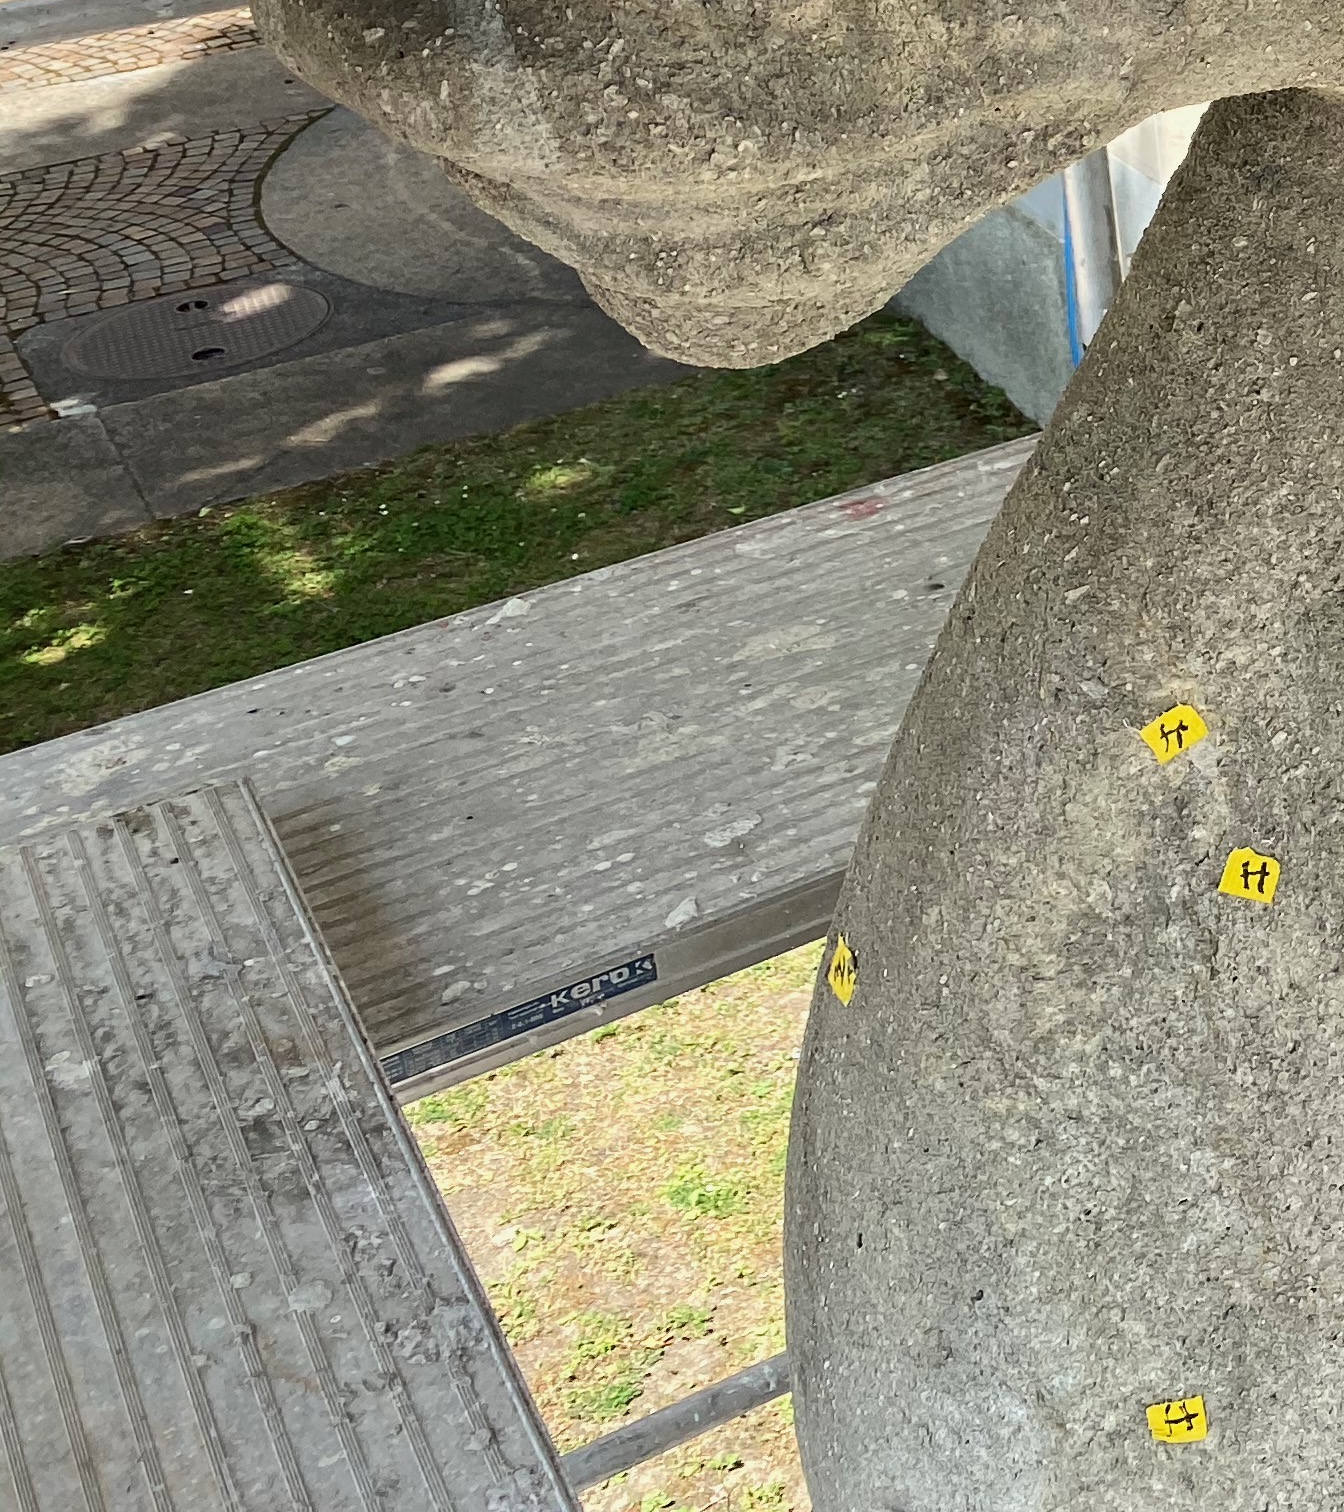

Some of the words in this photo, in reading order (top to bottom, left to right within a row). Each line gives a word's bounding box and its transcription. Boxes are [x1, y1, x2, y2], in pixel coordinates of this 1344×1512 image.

[1159, 719, 1189, 752] H
[1239, 860, 1270, 895] H
[550, 967, 630, 1009] kero
